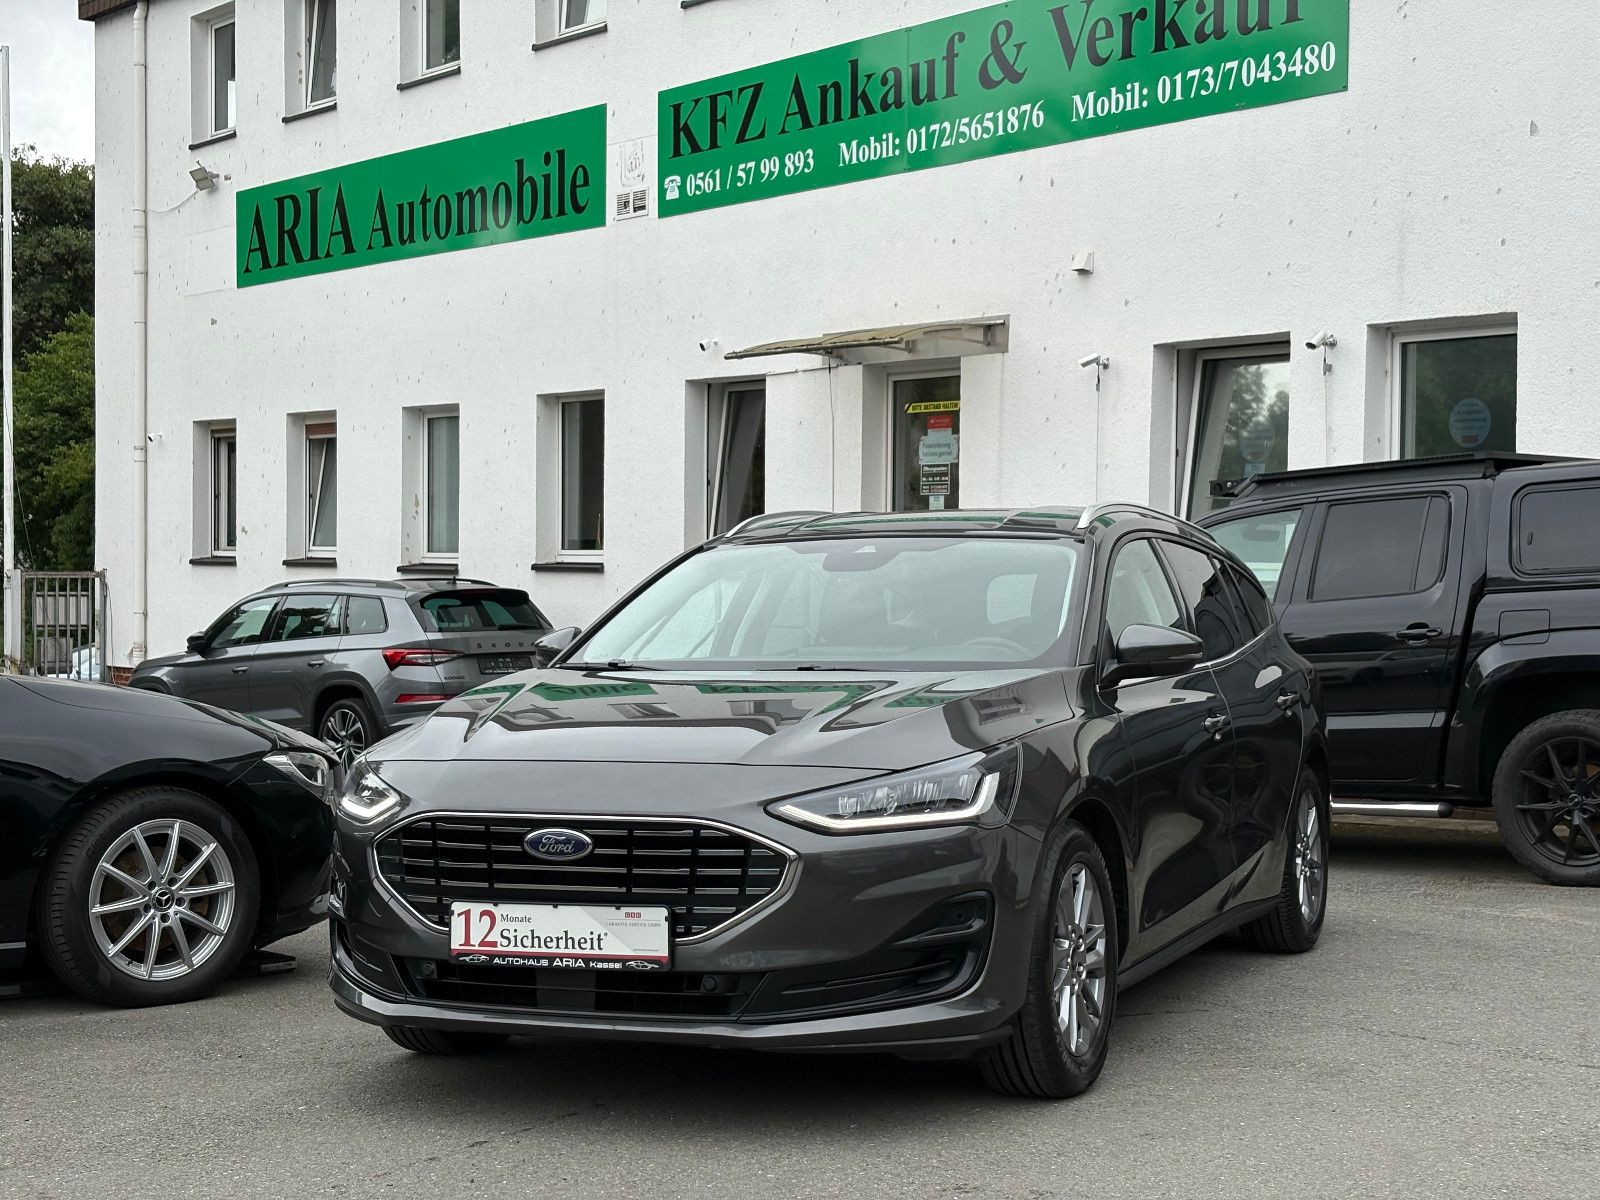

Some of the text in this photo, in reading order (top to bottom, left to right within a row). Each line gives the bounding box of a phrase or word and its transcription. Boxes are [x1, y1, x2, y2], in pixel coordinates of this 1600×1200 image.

[669, 81, 766, 160] KFZ
[777, 31, 966, 135] Ankauf
[978, 19, 1028, 91] &
[686, 41, 1336, 197] 0561 / 57 99 893 Mobil: 0172/5651876 Mobil: 0173/7043480
[242, 148, 590, 273] ARIA Automobile
[537, 834, 575, 854] Ford
[456, 907, 532, 948] 12 Monate
[492, 957, 623, 969] AUTOHAUS ARIA Kassel
